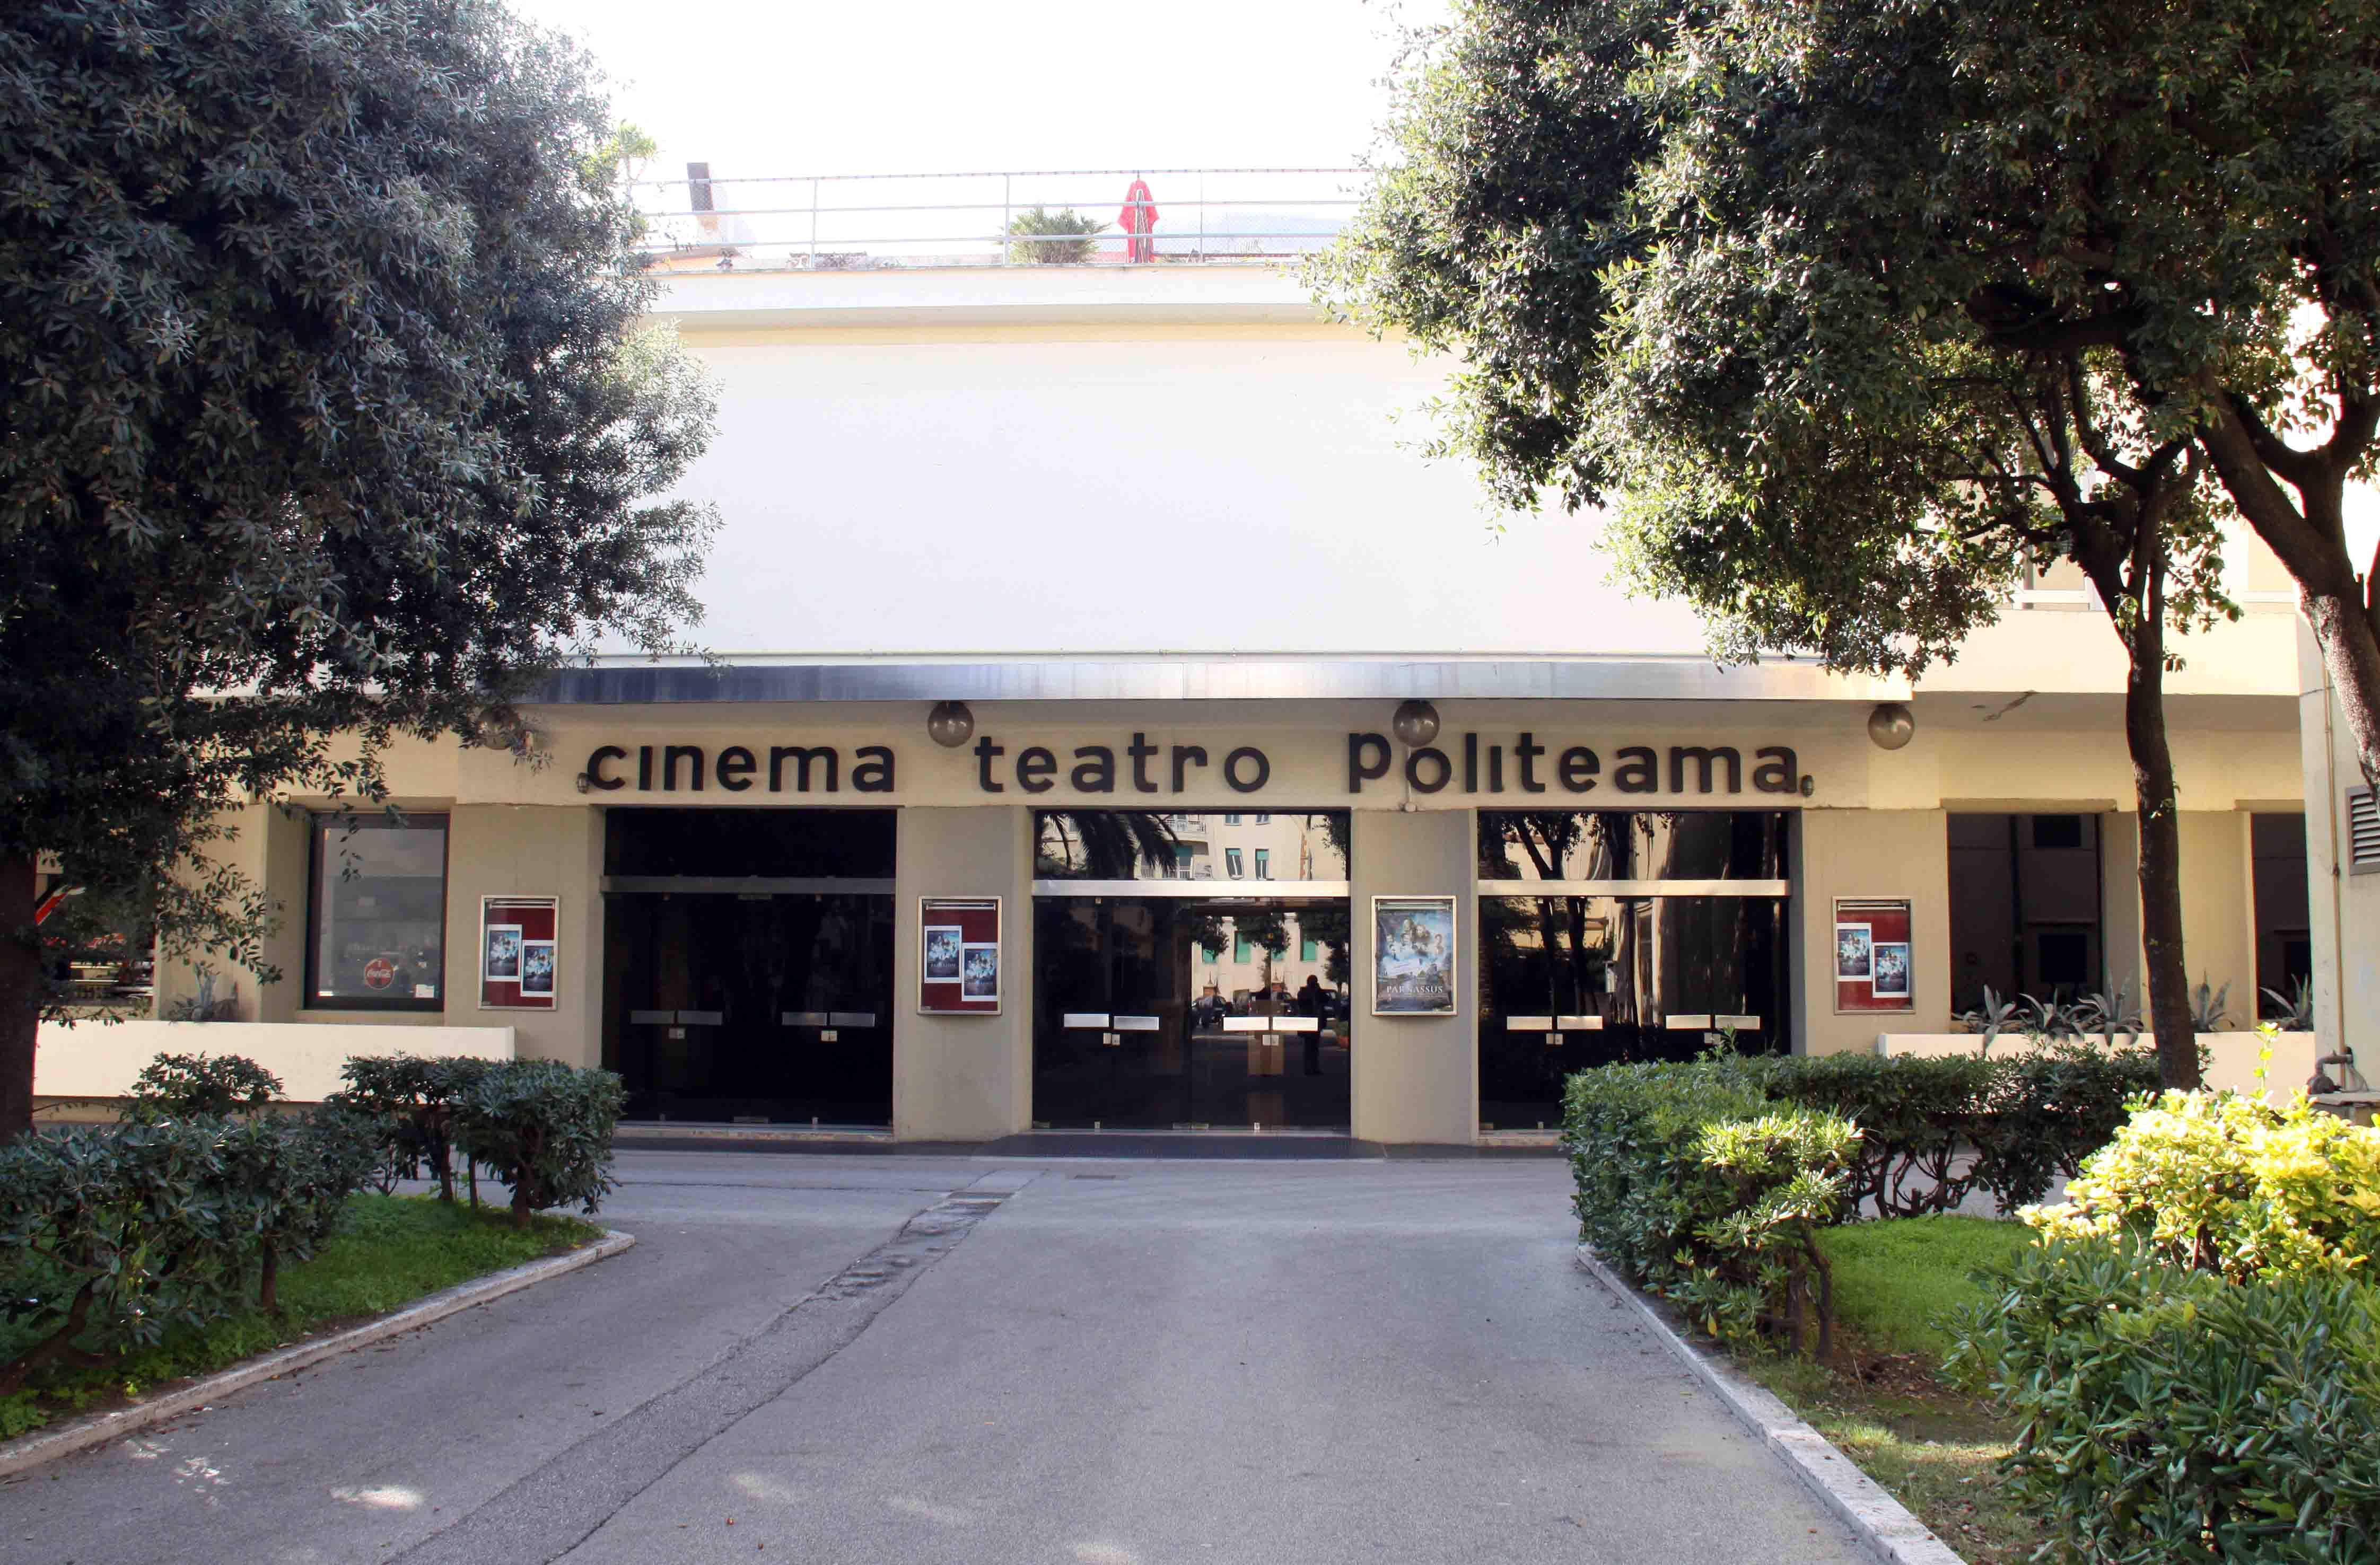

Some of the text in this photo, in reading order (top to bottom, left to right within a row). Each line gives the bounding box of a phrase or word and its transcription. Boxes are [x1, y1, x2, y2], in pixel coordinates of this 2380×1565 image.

[587, 732, 1798, 794] cinema teatro politeama
